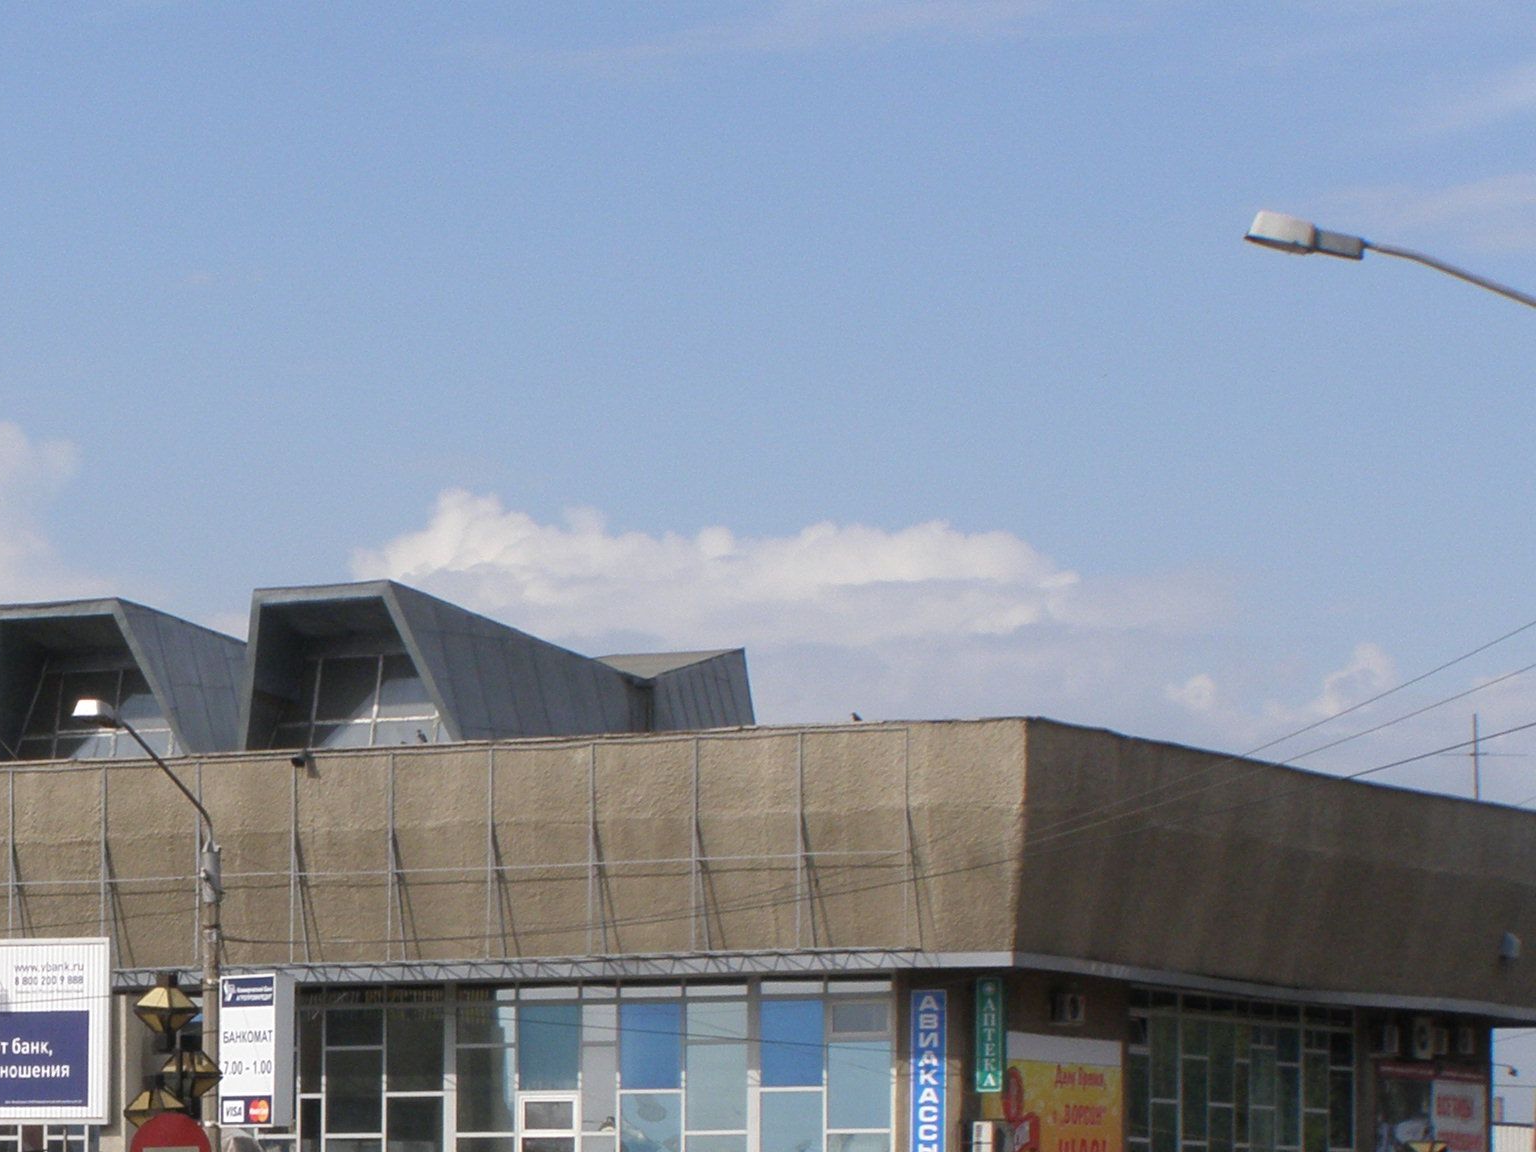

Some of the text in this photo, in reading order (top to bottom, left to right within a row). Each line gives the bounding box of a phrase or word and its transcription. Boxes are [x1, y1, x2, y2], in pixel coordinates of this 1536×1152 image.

[15, 976, 20, 986] 8
[22, 976, 38, 986] 800
[41, 975, 57, 985] 200
[67, 975, 84, 985] 888
[223, 1029, 273, 1044] БАНКОМАТ
[981, 999, 997, 1087] АПТЕКА
[12, 1037, 53, 1057] банк,
[224, 1061, 244, 1076] 7.00
[253, 1060, 273, 1075] 1.00
[225, 1106, 243, 1117] VISA
